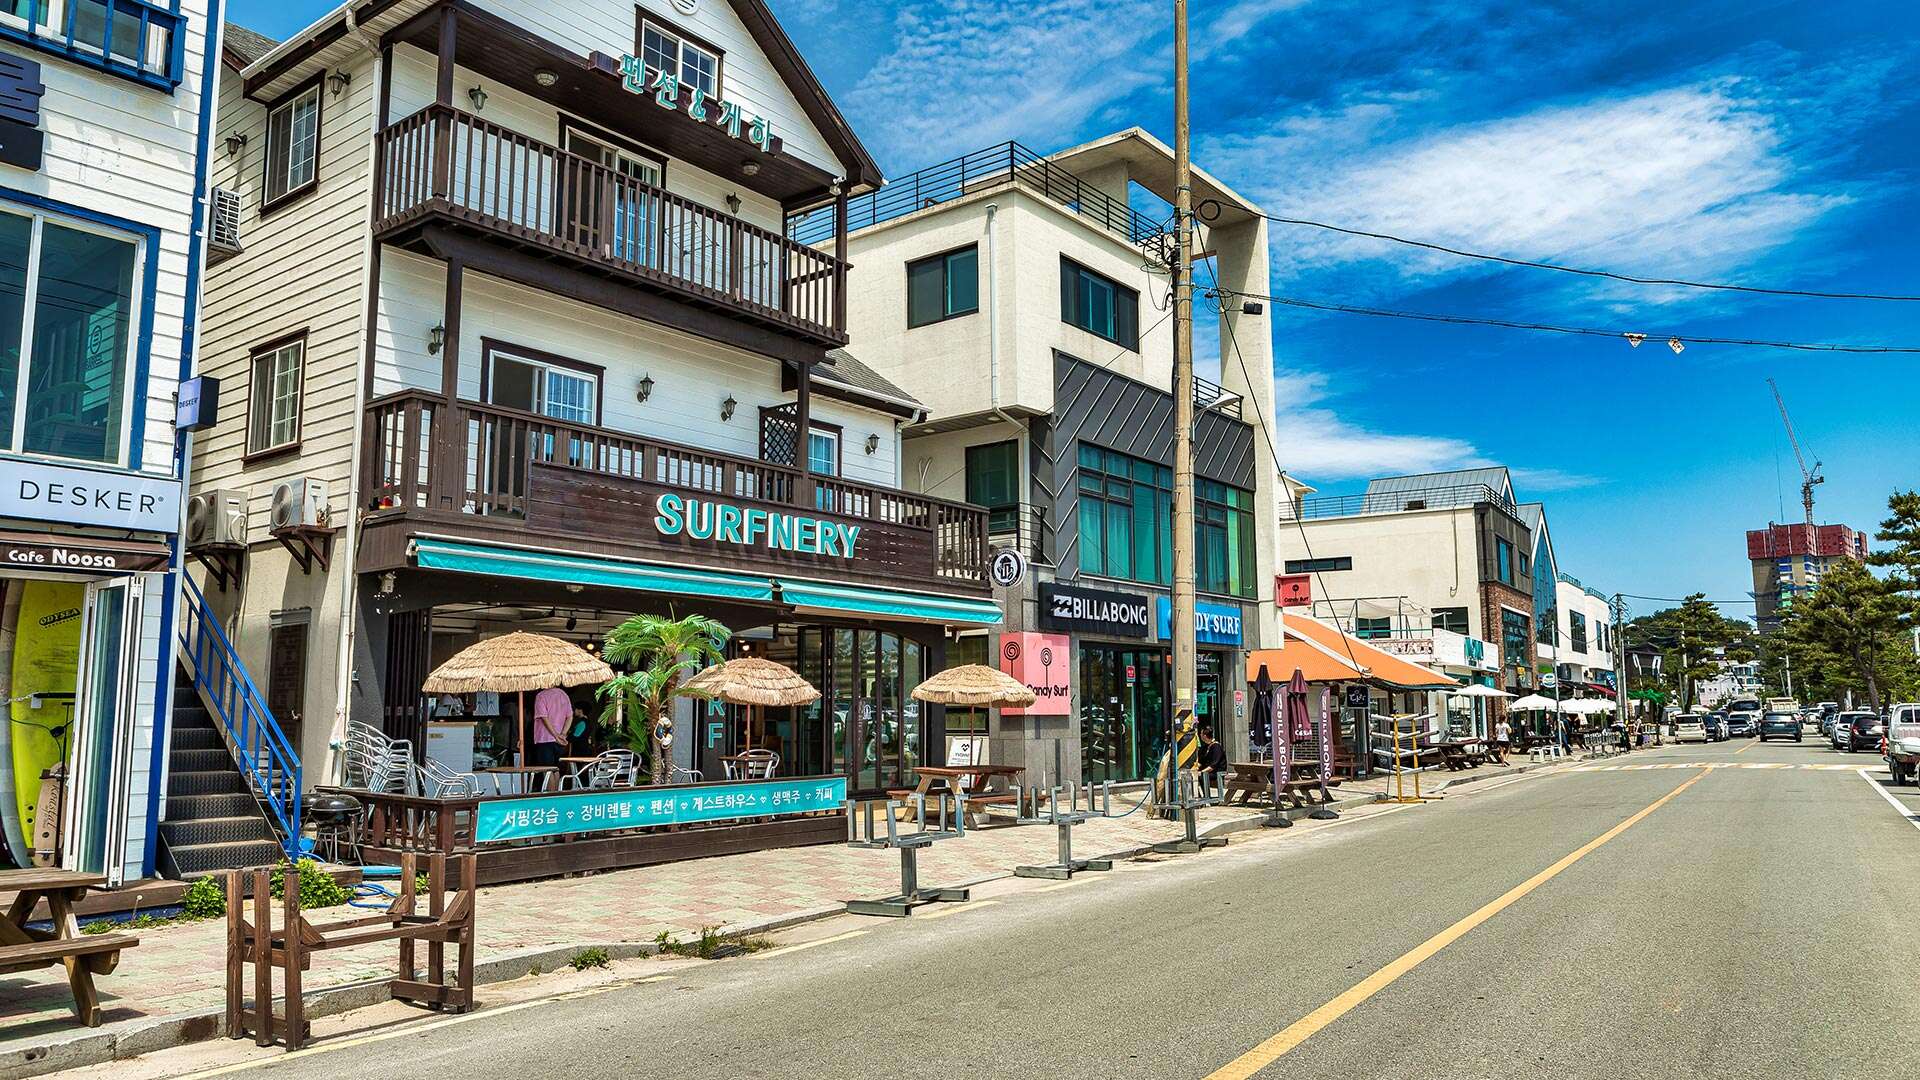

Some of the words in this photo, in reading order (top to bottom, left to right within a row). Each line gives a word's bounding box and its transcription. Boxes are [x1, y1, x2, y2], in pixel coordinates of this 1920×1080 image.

[654, 493, 861, 559] SURFNERY
[8, 550, 46, 563] Cafe
[52, 548, 117, 568] Noosa
[1073, 598, 1147, 626] BILLABONG
[1213, 614, 1241, 635] SURF
[708, 626, 726, 749] SRF
[1053, 684, 1069, 697] Surf
[1276, 711, 1288, 784] BILLABONG
[502, 808, 559, 827] 서핑강습
[581, 802, 632, 821] 장비렌탈
[692, 793, 756, 812] 게스트하우스
[771, 790, 800, 805] 생맥주
[814, 787, 833, 802] 커피
